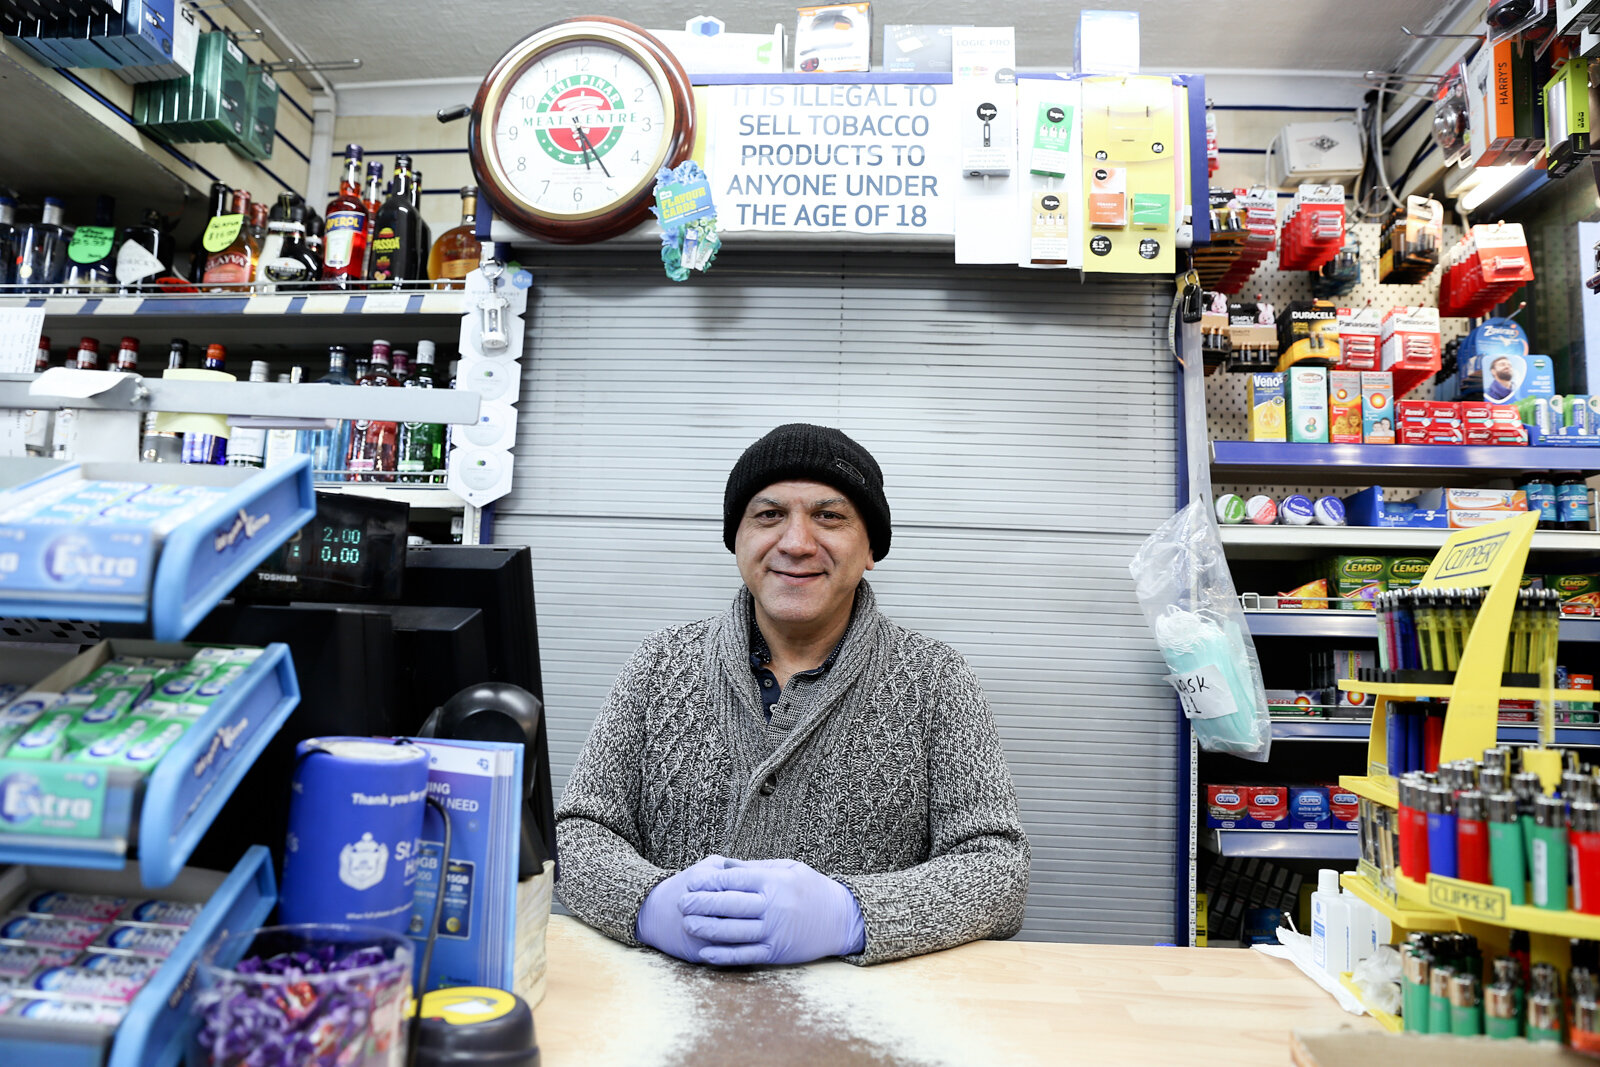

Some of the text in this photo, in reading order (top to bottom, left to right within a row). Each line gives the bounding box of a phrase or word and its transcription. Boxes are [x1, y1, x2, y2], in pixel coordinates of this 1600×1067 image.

[575, 57, 590, 72] 12
[545, 68, 558, 83] 11
[541, 75, 621, 105] YENI PINAR
[1497, 62, 1508, 105] HARRY'S
[520, 95, 535, 110] 10
[634, 88, 644, 103] 2
[733, 85, 937, 107] IT IS ILLEGAL TO
[524, 112, 637, 127] MEAT ENTRE
[641, 117, 651, 132] 3
[739, 114, 929, 136] SELL TOBACCO
[508, 126, 518, 141] 9
[630, 150, 640, 164] 4
[741, 144, 925, 166] PRODUCTS TO
[517, 157, 526, 171] 8
[541, 180, 550, 195] 7
[726, 174, 938, 197] ANYONE UNDER
[573, 187, 582, 202] 6
[661, 187, 706, 209] FLAVOUR
[1301, 195, 1342, 203] Panasonic
[663, 200, 696, 219] CARDS
[1239, 201, 1274, 209] anasonic
[736, 204, 786, 226] THE
[793, 204, 847, 227] AGE
[855, 204, 890, 226] OF
[897, 205, 927, 227] 18
[1291, 311, 1335, 320] DURACELL
[1395, 317, 1436, 326] Panasonic
[1339, 319, 1379, 329] Panasonic
[1425, 510, 1436, 521] 3
[322, 526, 361, 544] 2.00
[51, 545, 138, 577] Extra
[321, 545, 360, 564] 0.00
[1445, 543, 1499, 571] CLIPPER
[1345, 563, 1383, 573] LEMSIP
[258, 572, 298, 582] TOSHIBA
[3, 781, 93, 820] Extra
[351, 792, 389, 805] Thank
[390, 793, 408, 807] you
[446, 797, 479, 813] NEED
